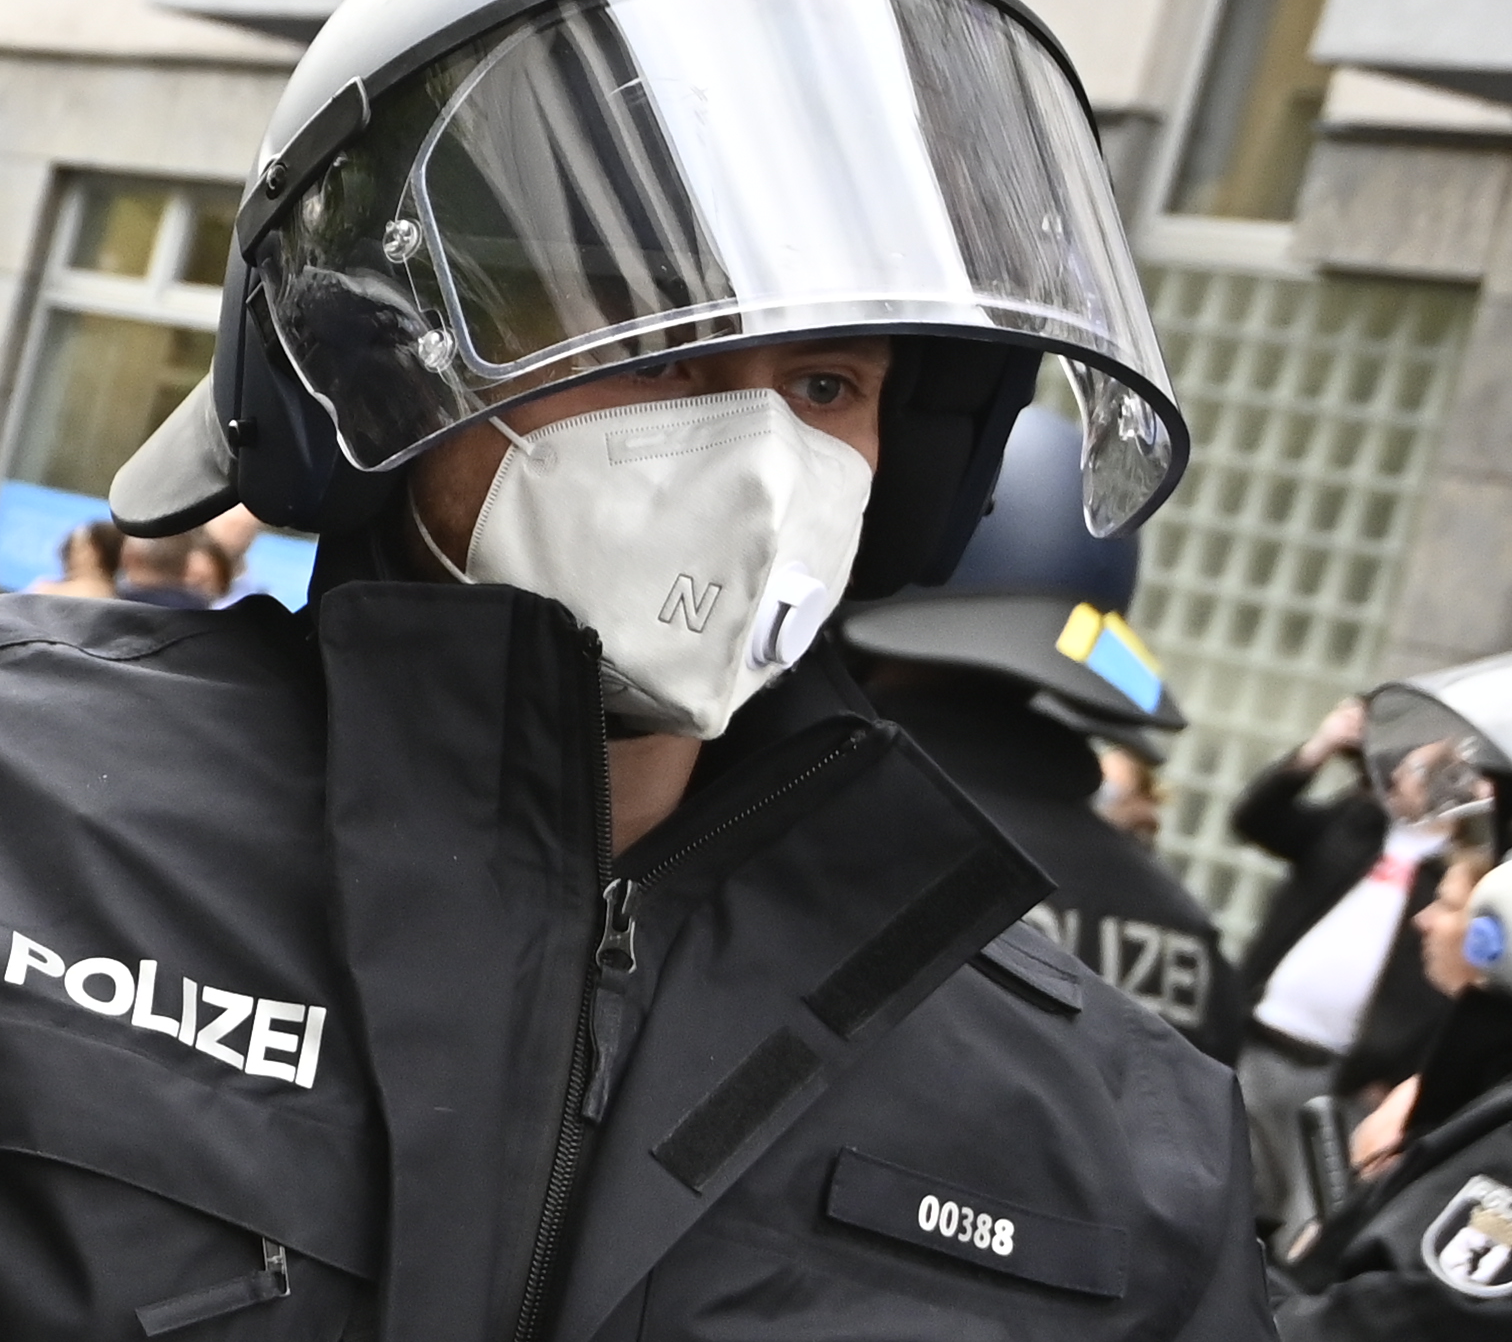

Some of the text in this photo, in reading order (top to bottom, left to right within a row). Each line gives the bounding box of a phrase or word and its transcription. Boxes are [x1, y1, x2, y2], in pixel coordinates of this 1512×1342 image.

[657, 573, 723, 634] N
[3, 930, 327, 1089] POLIZEI
[917, 1193, 1015, 1256] 00388
